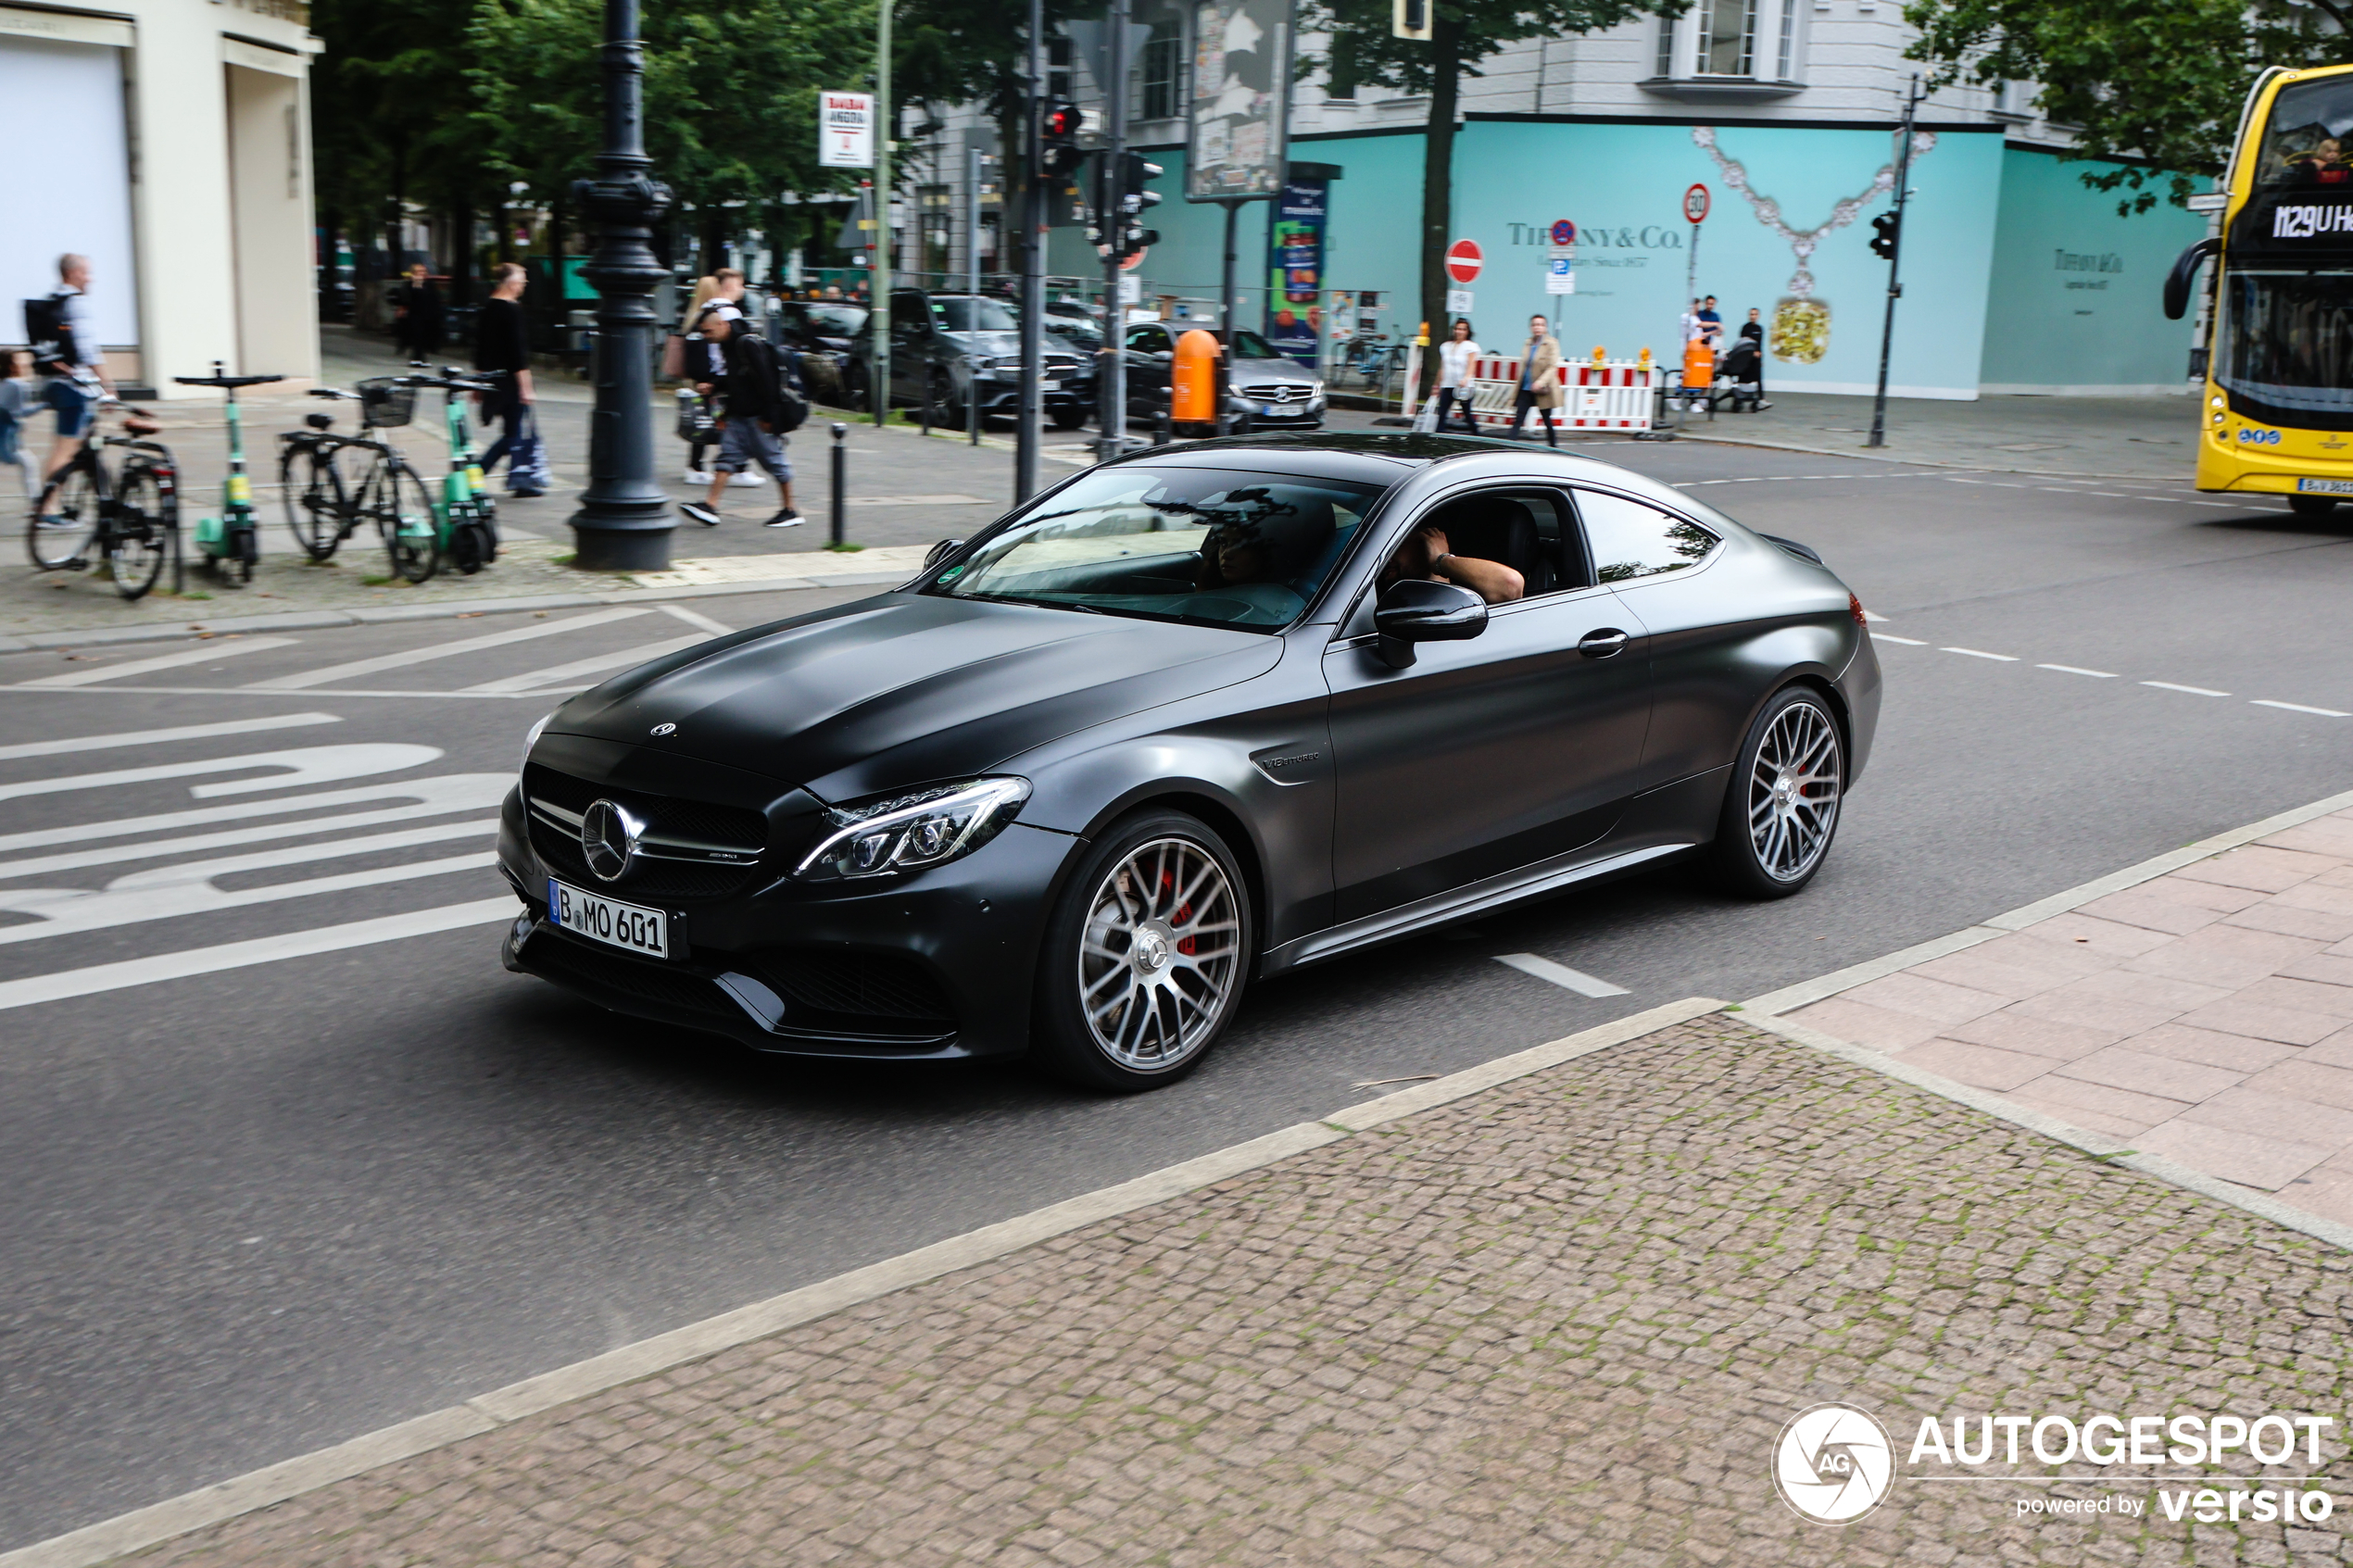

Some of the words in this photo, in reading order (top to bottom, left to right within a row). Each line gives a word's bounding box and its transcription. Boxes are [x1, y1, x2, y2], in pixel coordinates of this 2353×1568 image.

[2272, 205, 2317, 237] M29
[560, 888, 572, 923] B
[583, 897, 611, 938] MO
[616, 909, 662, 952] 601
